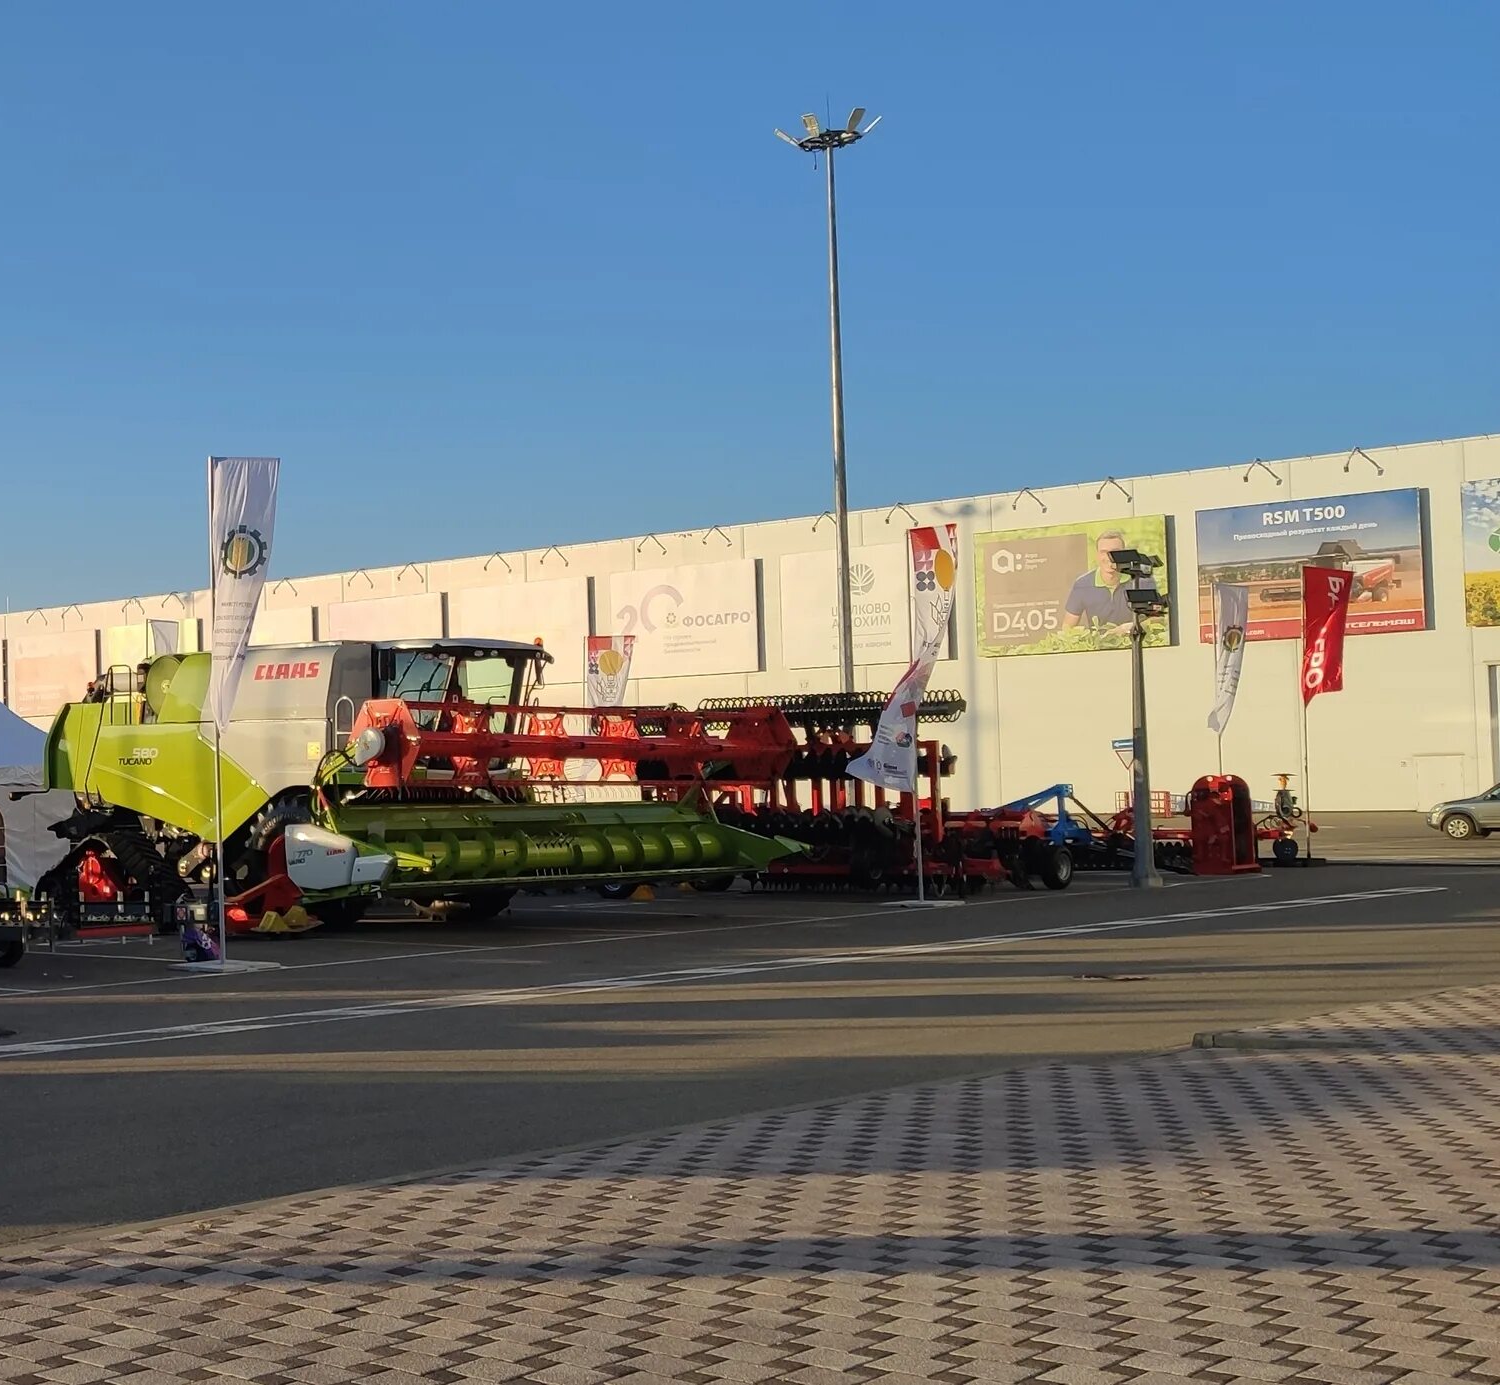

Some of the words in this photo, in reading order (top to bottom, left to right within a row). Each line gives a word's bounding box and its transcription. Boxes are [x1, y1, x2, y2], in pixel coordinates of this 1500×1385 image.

[1262, 509, 1300, 526] RSM
[1303, 505, 1346, 522] T500
[682, 611, 751, 627] ФОСАГРО
[832, 615, 891, 629] АОХИМ
[993, 608, 1058, 633] D405
[254, 662, 320, 681] CLAAS
[132, 747, 159, 758] 580
[118, 758, 153, 766] TUCANO
